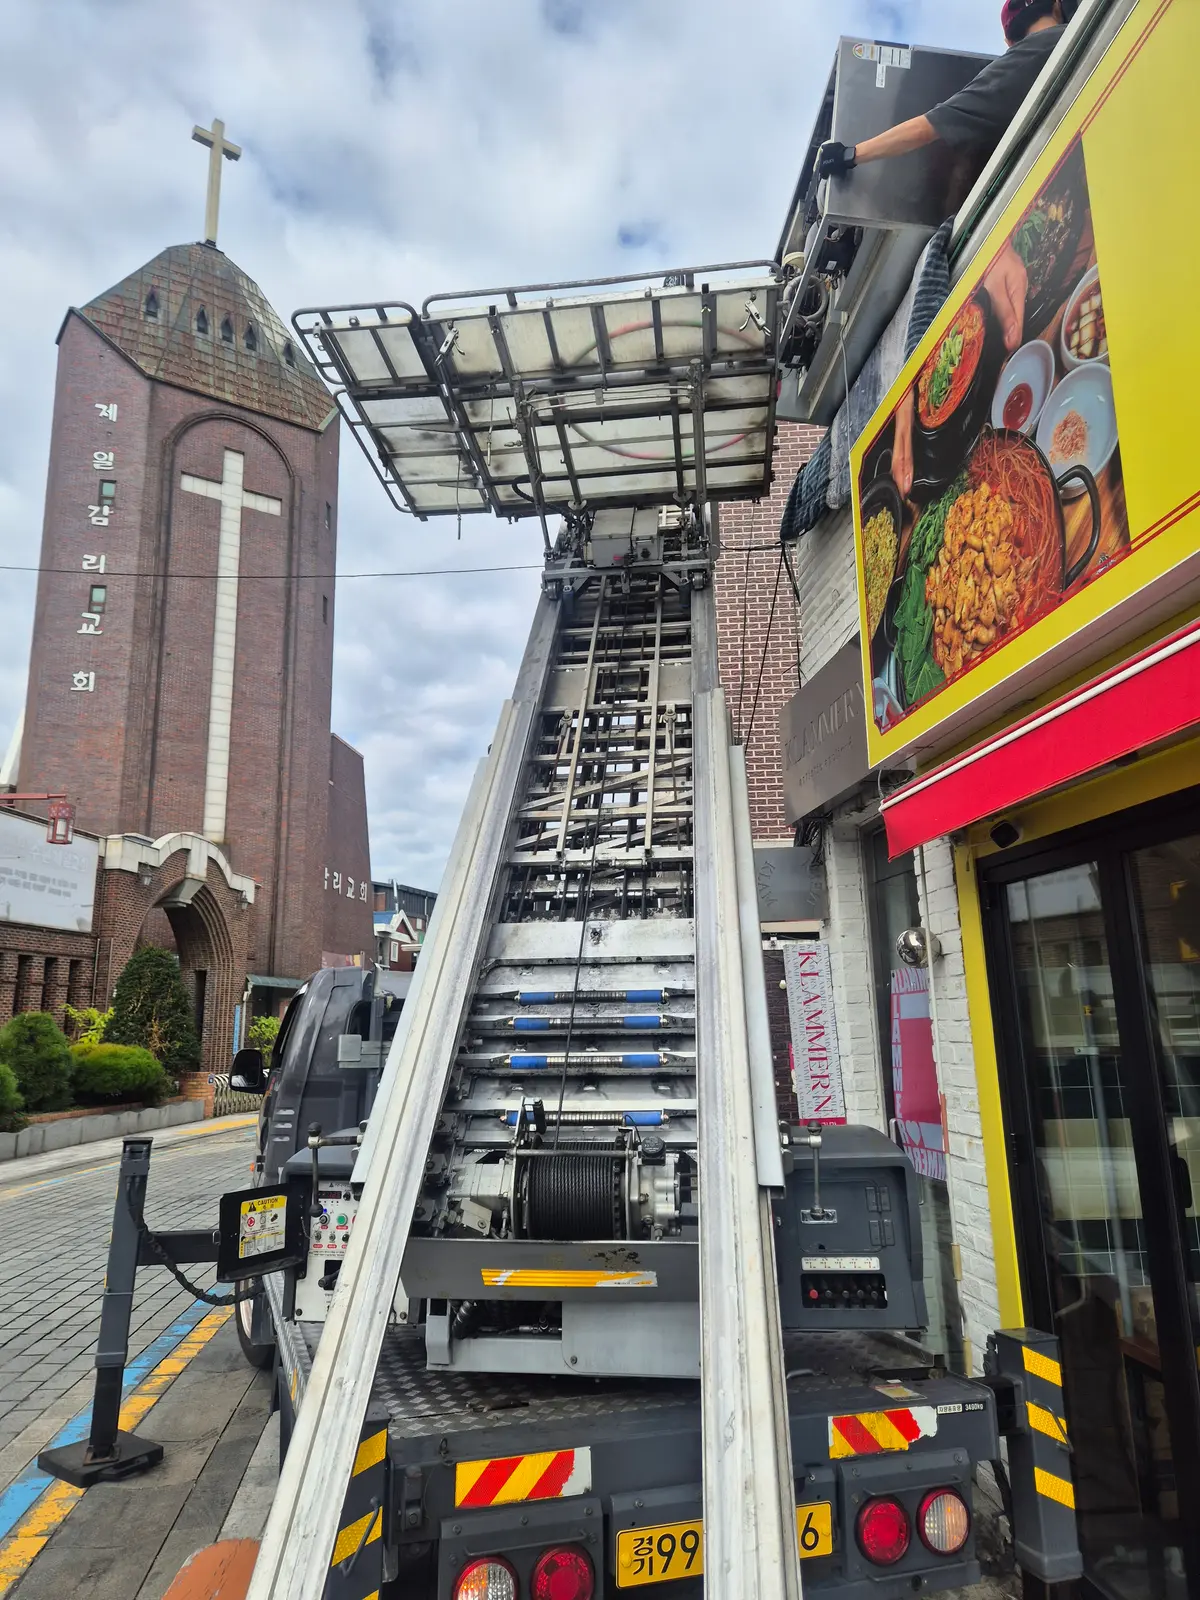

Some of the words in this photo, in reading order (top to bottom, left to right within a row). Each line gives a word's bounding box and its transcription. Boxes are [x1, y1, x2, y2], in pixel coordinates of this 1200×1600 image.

[70, 402, 118, 693] 제일감리교회
[798, 951, 832, 1112] KLAMMERN
[257, 1197, 279, 1206] CAUTION
